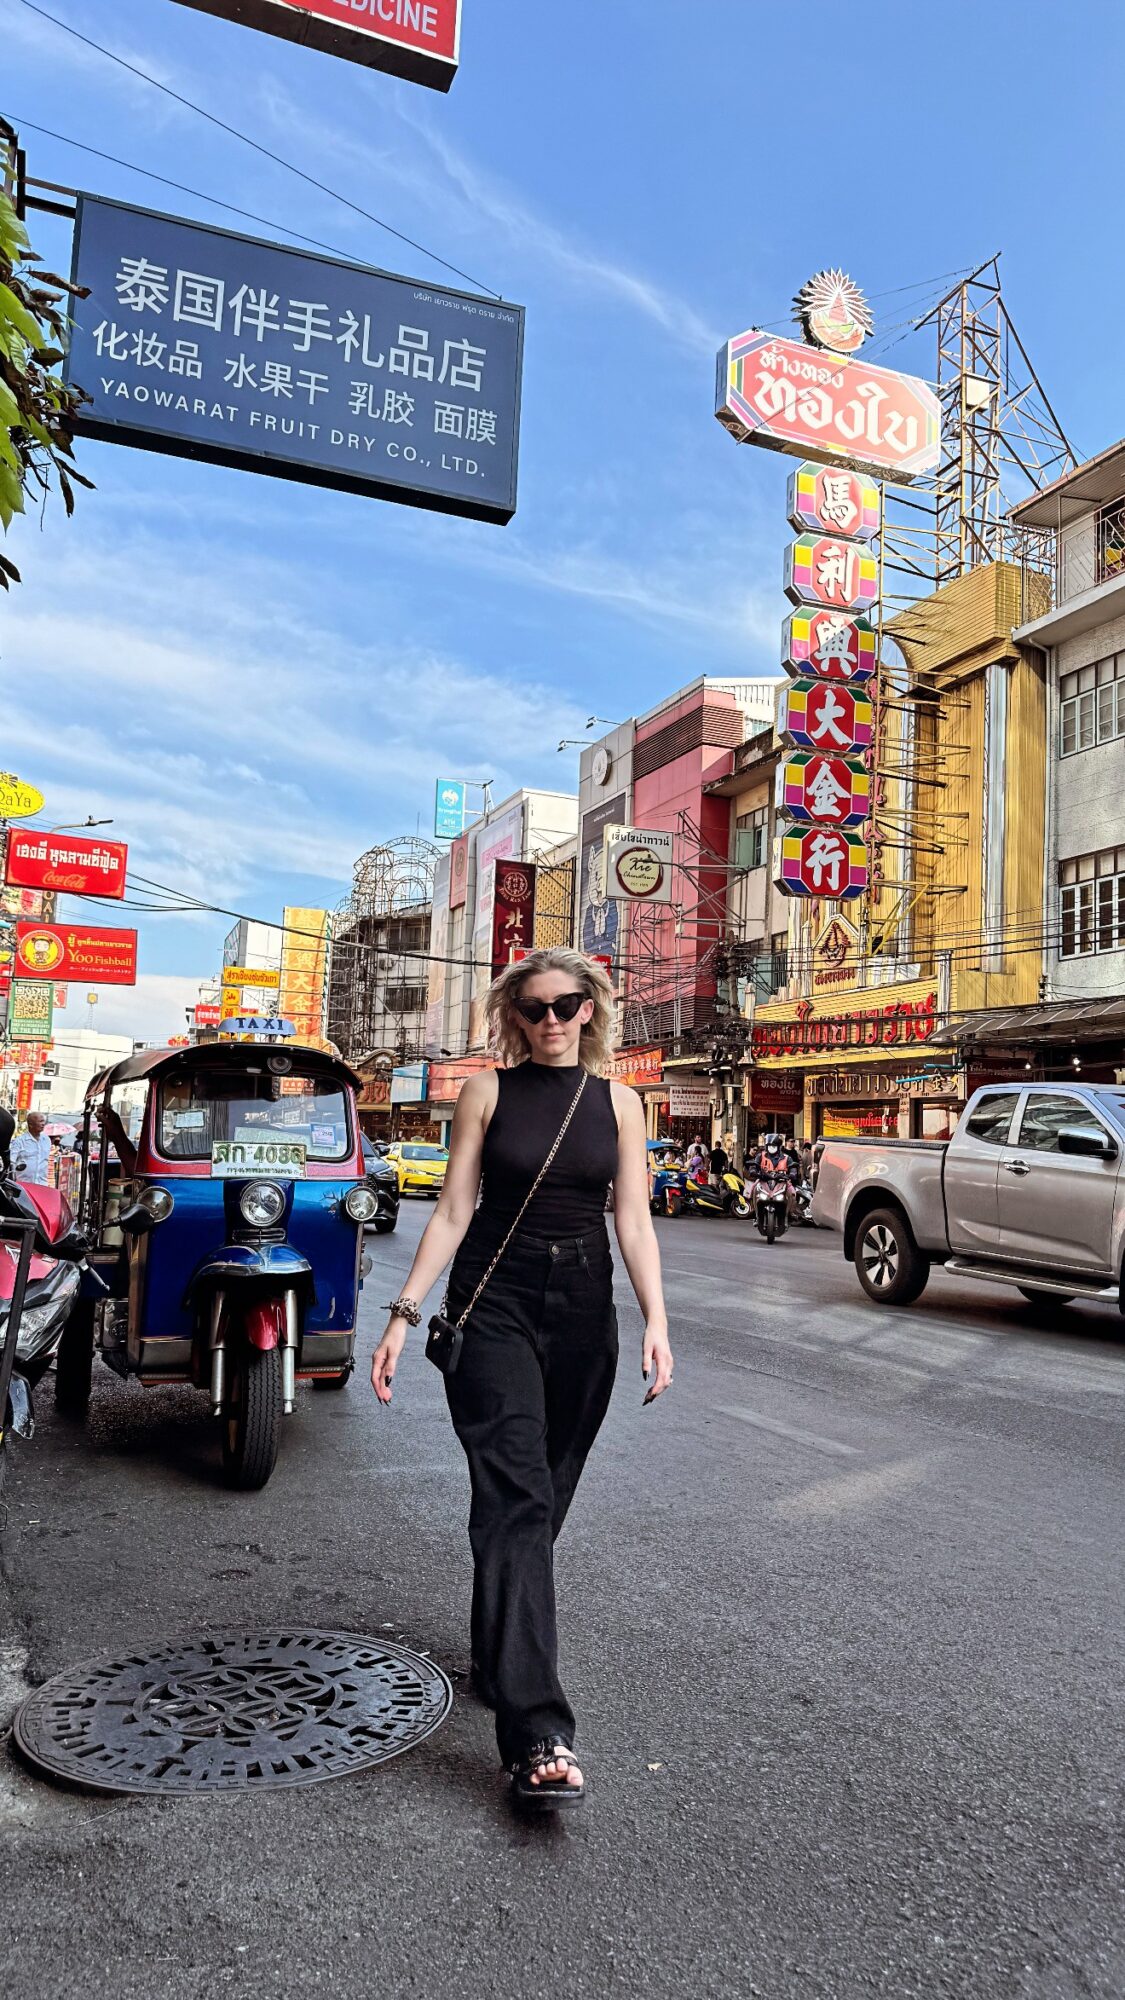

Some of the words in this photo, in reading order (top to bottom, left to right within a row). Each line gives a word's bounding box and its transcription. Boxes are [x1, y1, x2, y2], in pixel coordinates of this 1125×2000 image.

[333, 0, 438, 38] ICINE
[115, 257, 487, 393] 泰国伴手礼品店
[92, 320, 203, 380] 化妆品
[223, 353, 330, 405] 水果干
[348, 380, 416, 427] 乳胶
[434, 400, 498, 446] 面膜
[759, 347, 845, 389] ห้างทอง
[100, 377, 239, 422] YAOWARAT
[249, 411, 321, 440] FRUIT
[330, 429, 376, 452] DRY
[386, 442, 432, 468] CO.,
[441, 453, 486, 477] LTD.
[754, 371, 919, 454] ทองใบ
[805, 473, 859, 892] 馬利興大金行
[67, 949, 94, 964] Yoo
[94, 955, 132, 967] Fishball
[235, 1017, 284, 1031] TAXI
